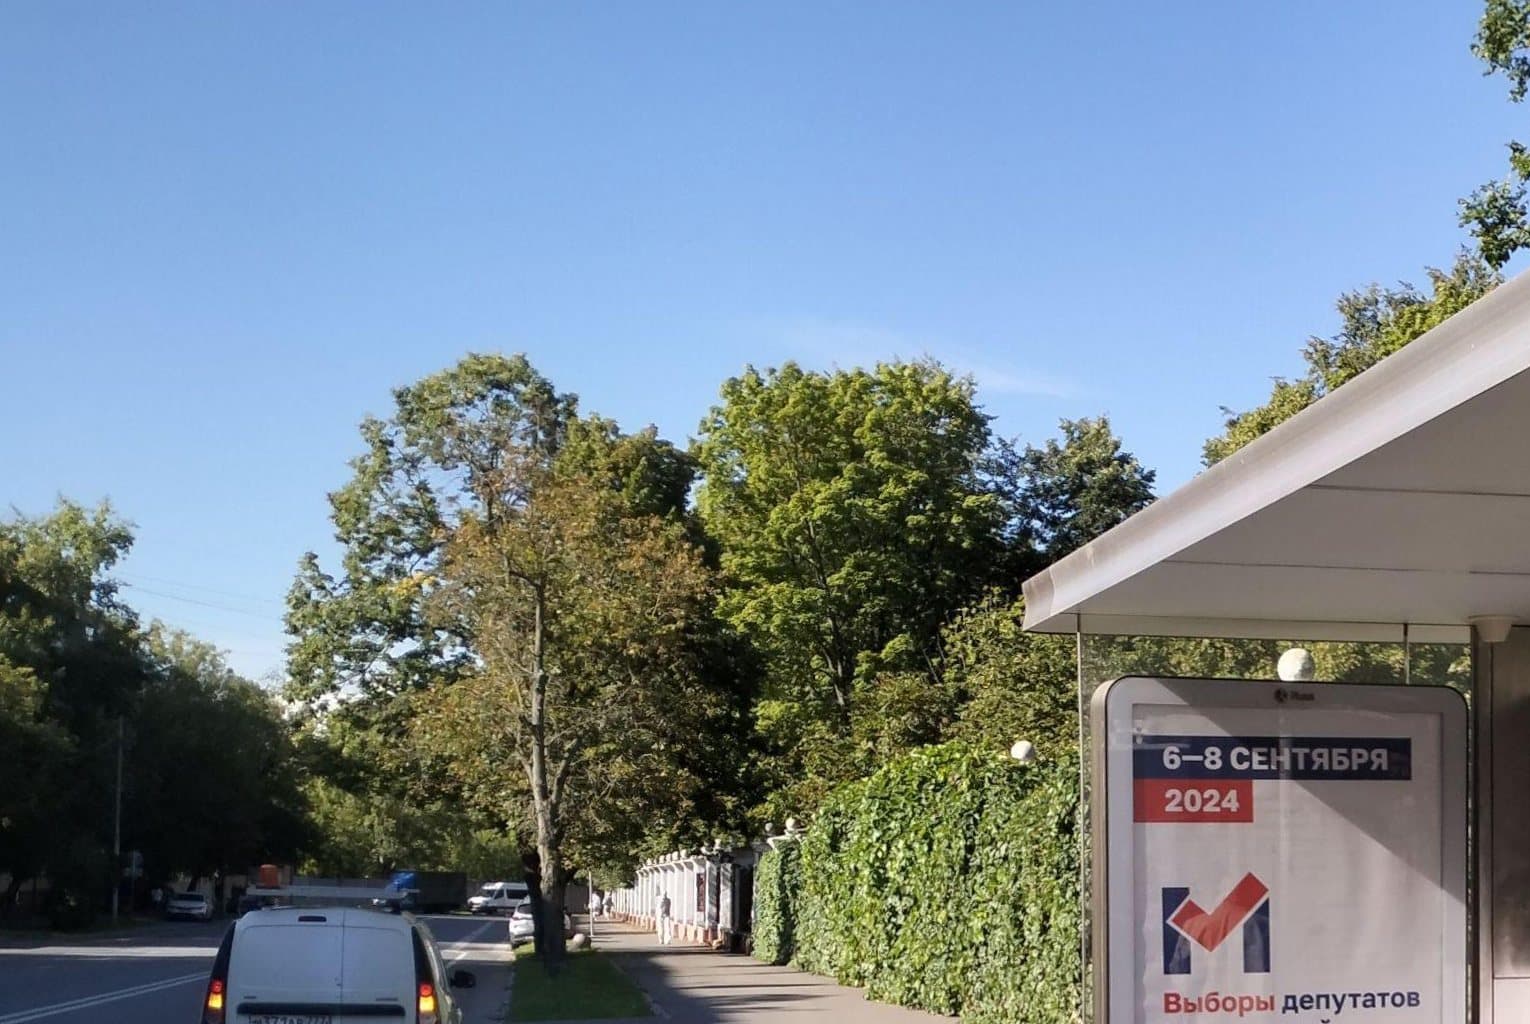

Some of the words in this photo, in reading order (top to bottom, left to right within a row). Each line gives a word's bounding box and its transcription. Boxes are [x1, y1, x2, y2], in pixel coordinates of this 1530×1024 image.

[1229, 746, 1389, 772] СЕНТЯБРЯ
[1164, 788, 1241, 813] 2024
[1163, 991, 1276, 1017] Выборы
[1281, 991, 1421, 1016] депутатов
